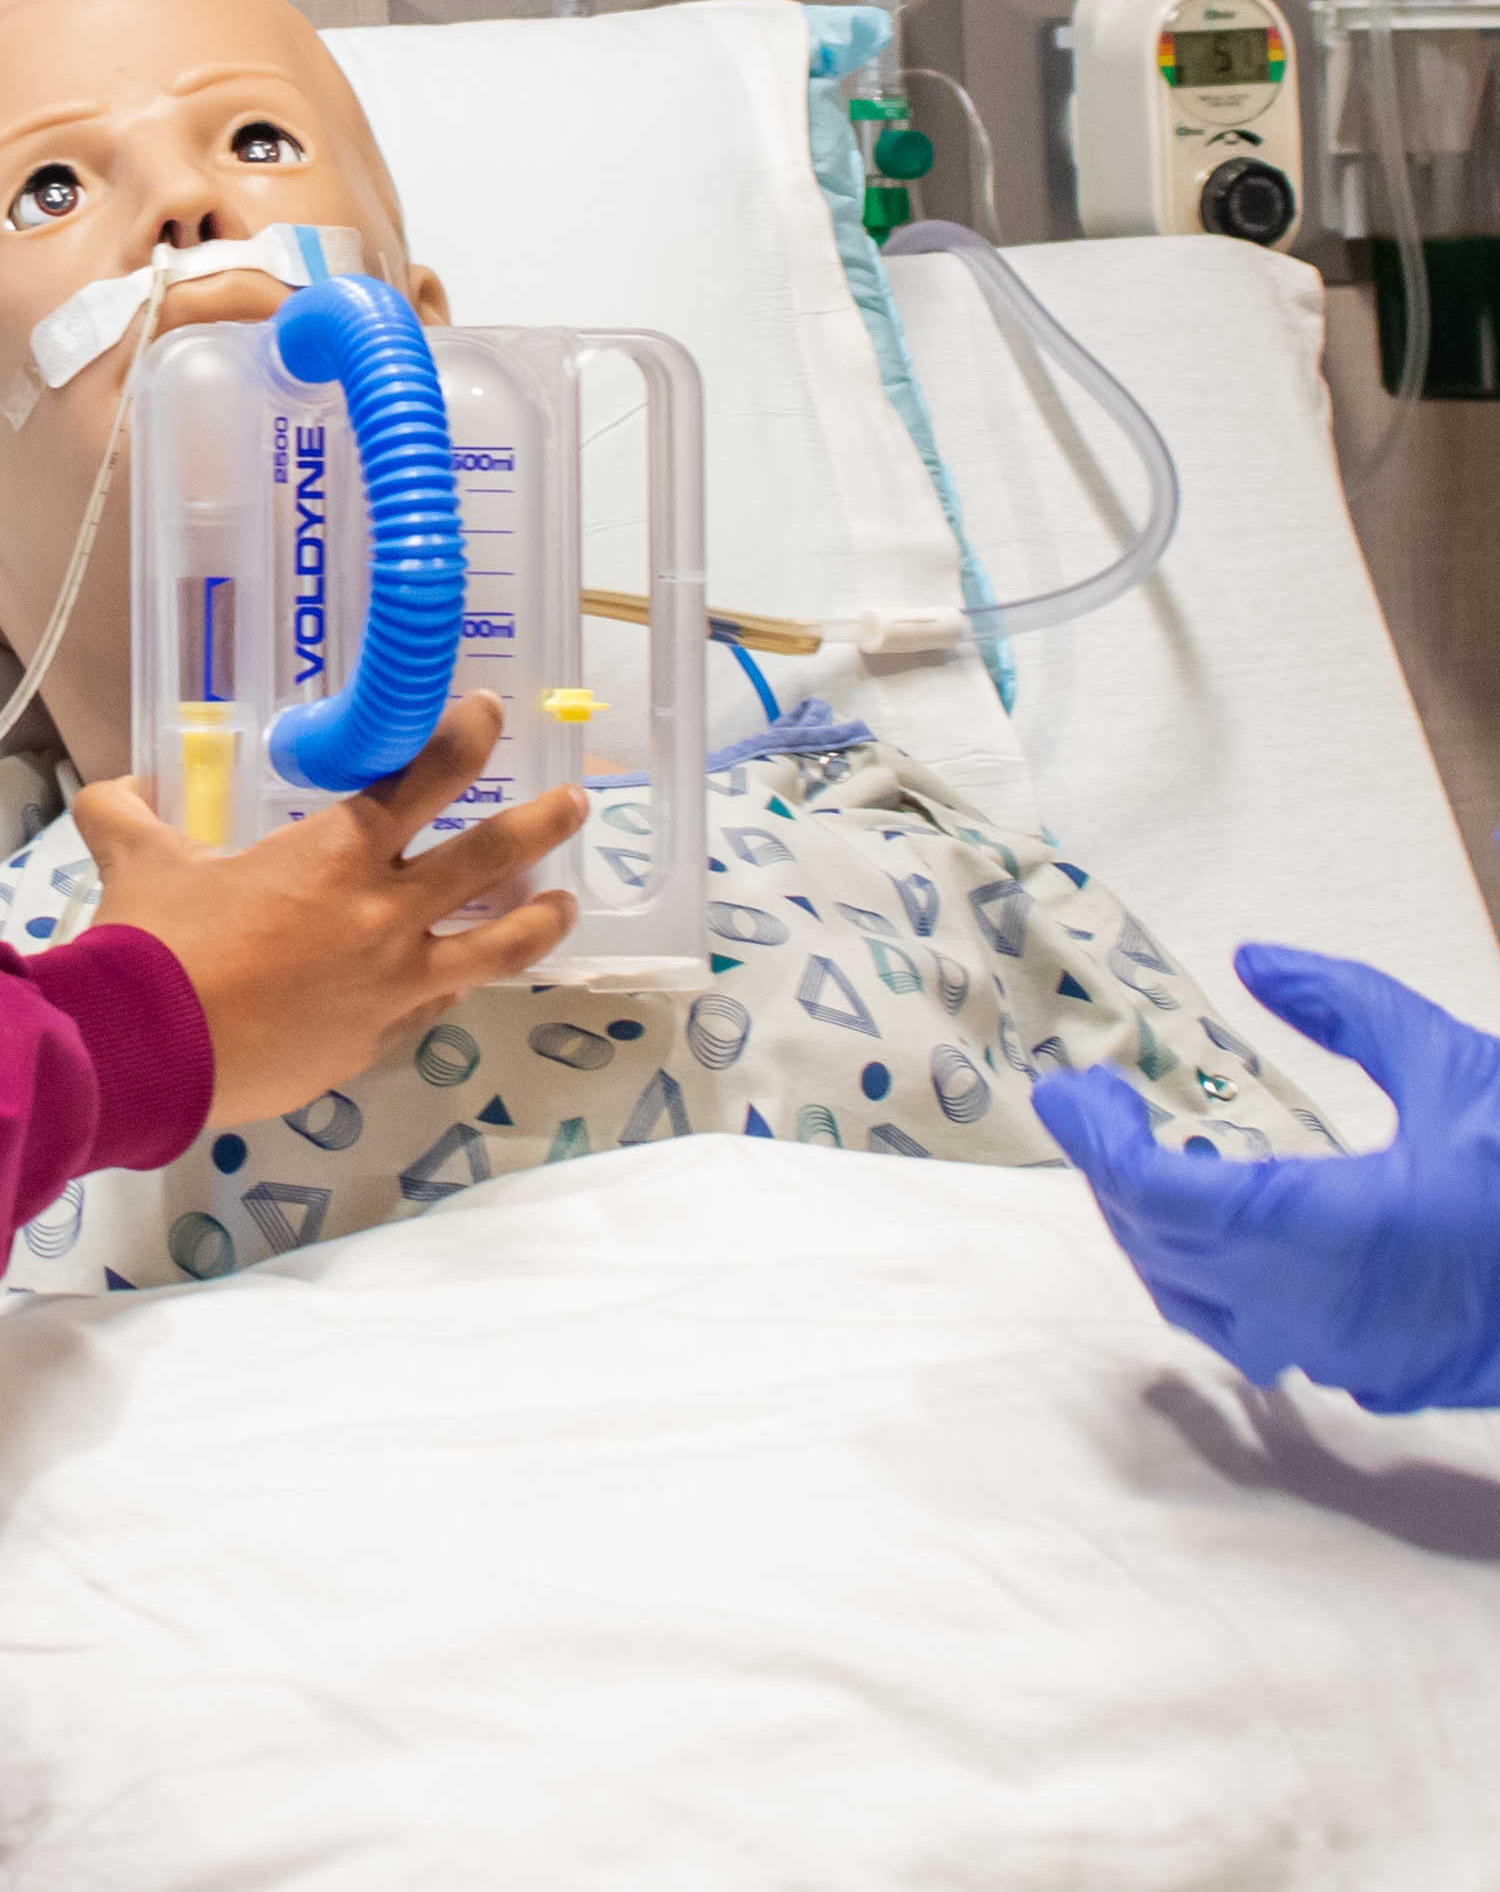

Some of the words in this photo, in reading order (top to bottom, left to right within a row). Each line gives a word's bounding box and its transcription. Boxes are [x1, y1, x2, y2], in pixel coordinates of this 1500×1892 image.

[274, 415, 289, 484] 2500
[294, 425, 325, 685] VOLDYNE
[462, 619, 516, 638] 00ml
